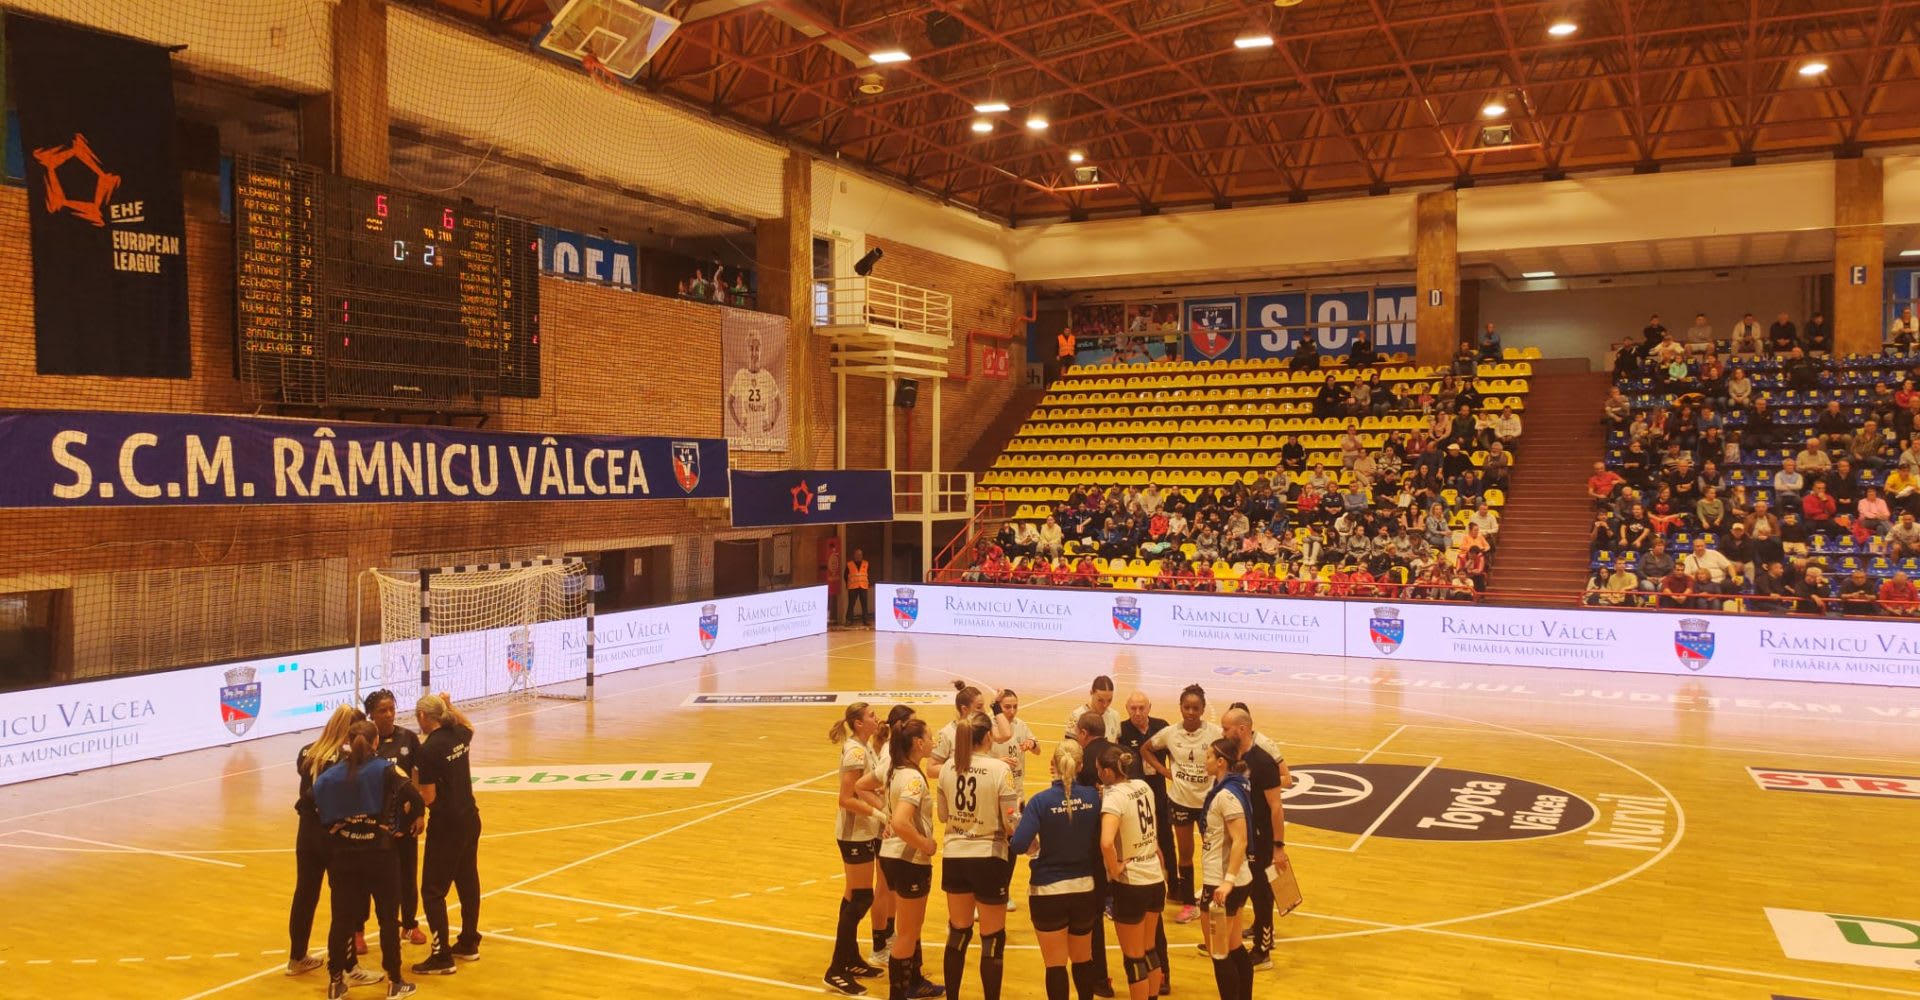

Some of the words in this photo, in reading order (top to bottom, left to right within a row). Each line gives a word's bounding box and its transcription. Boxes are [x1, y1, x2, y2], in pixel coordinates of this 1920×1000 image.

[110, 201, 144, 219] EHF
[377, 195, 388, 217] 6
[443, 208, 454, 230] 6
[112, 230, 180, 256] EUROPEAN
[113, 251, 161, 274] LEAGUE
[1853, 266, 1864, 285] E
[1431, 289, 1440, 306] D
[749, 389, 761, 402] 23
[51, 430, 255, 499] S.C.M.
[273, 427, 499, 497] RÂMNICU
[508, 436, 649, 496] VÂLCEA
[945, 595, 1012, 614] RÂMNICU
[1017, 598, 1072, 616] VÂLCEA
[1172, 604, 1250, 624] RÂMNICU
[1256, 608, 1320, 628] VÂLCEA
[1441, 616, 1533, 637] RÂMNICU
[1541, 620, 1617, 641] VÂLCEA
[1759, 629, 1867, 652] RÂMNICU
[1290, 672, 1536, 695] CONSILIUL
[57, 700, 156, 729] VÂLCEA
[21, 732, 139, 765] MUNICIPIULUI
[1188, 749, 1195, 763] 4
[954, 775, 977, 813] 83
[1416, 780, 1507, 830] Toyota
[1137, 795, 1155, 834] 64
[1510, 793, 1570, 830] Vâlcea
[1584, 792, 1669, 852] Nurvil
